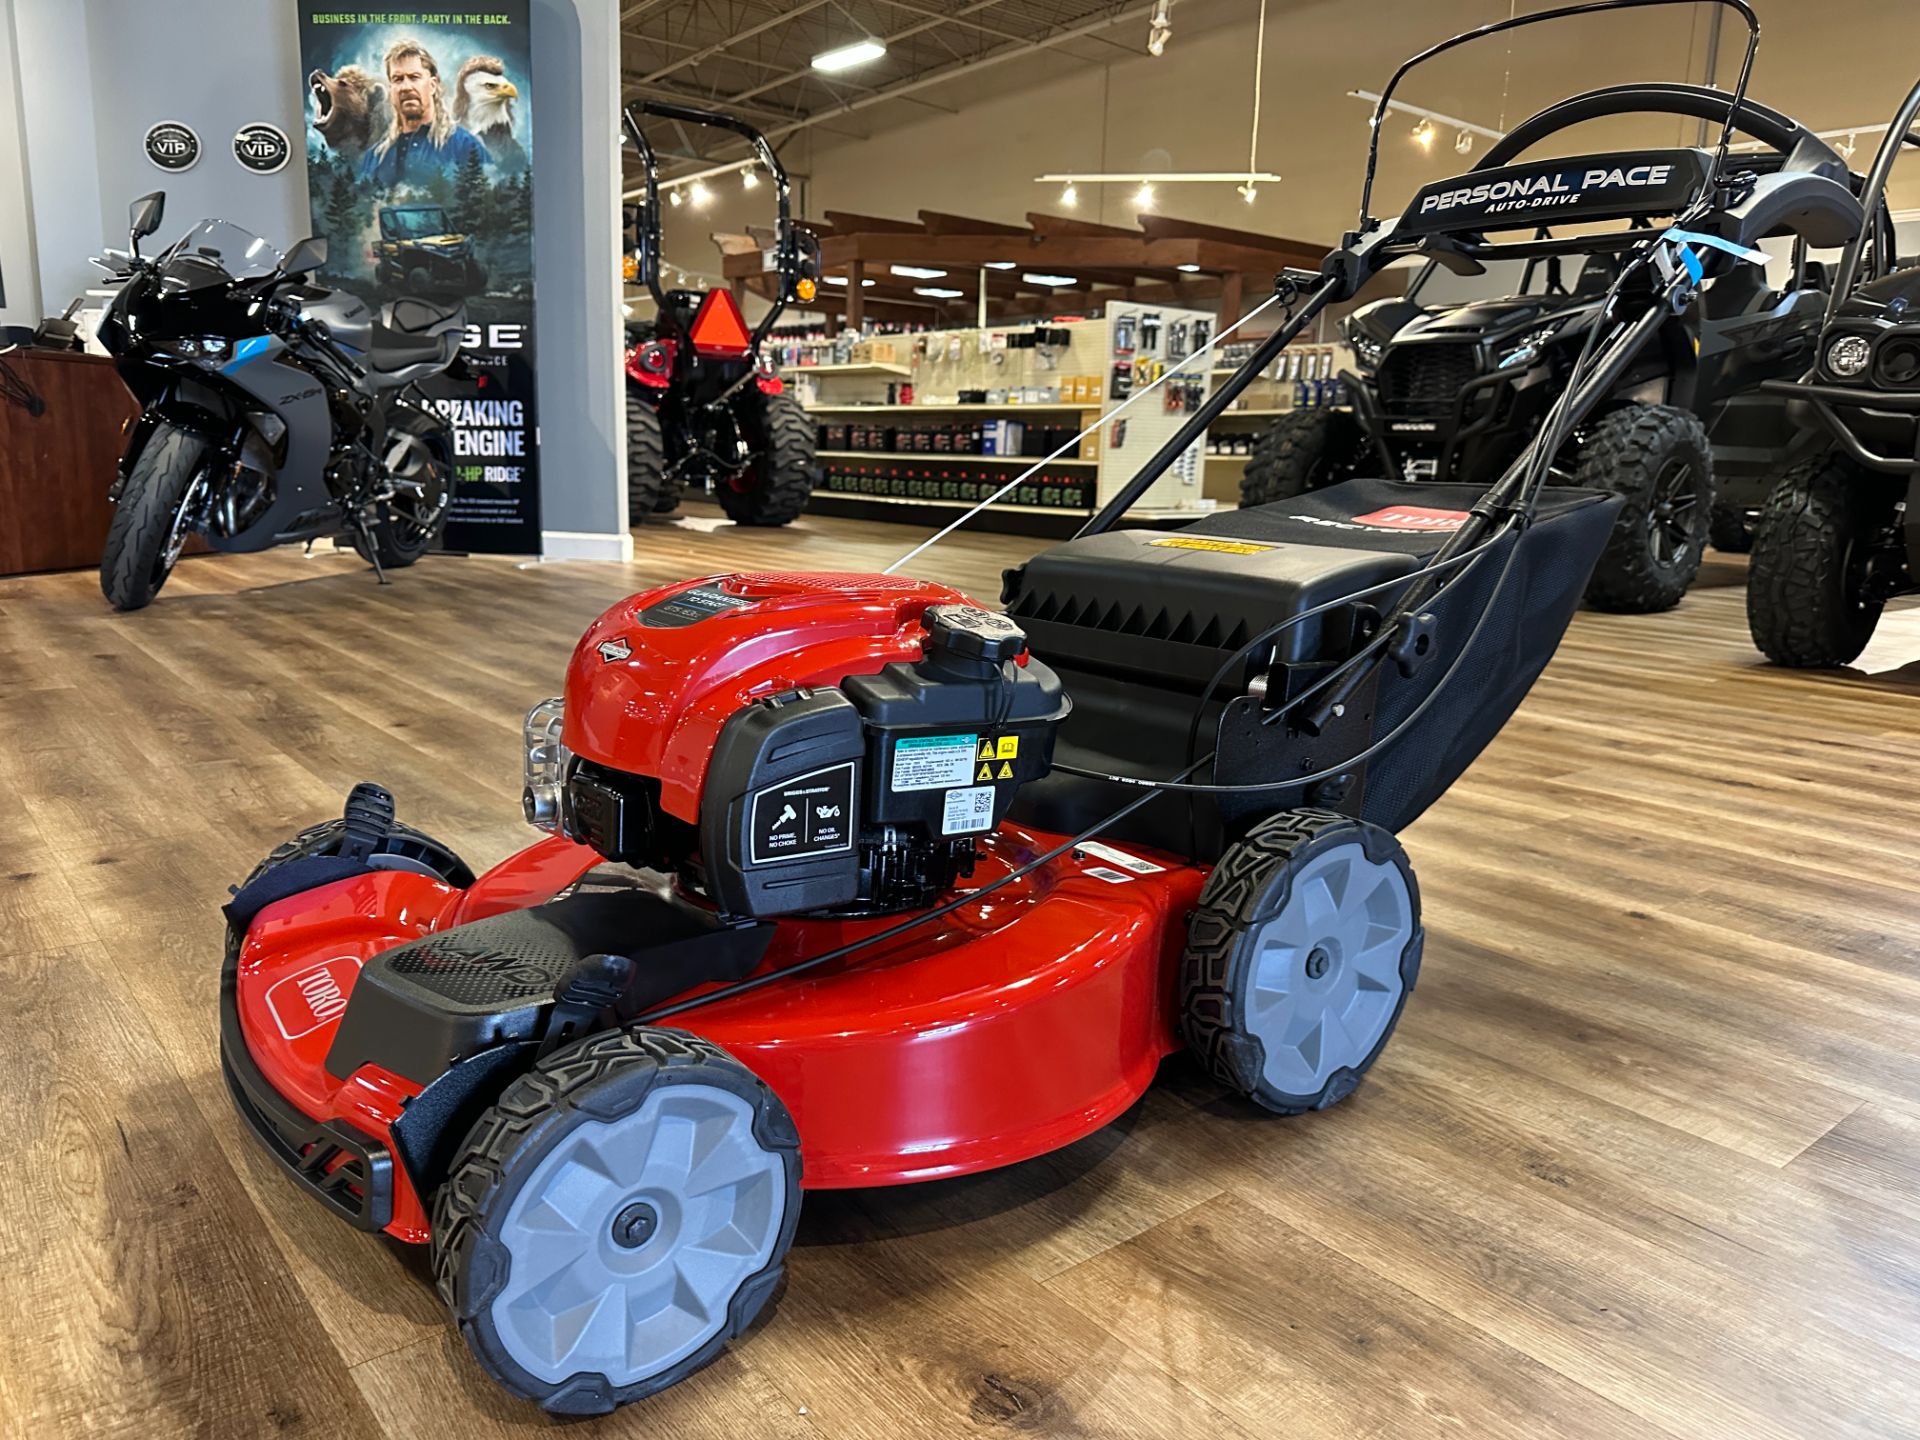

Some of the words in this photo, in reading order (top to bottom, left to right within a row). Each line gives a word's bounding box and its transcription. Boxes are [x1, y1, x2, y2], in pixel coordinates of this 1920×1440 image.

[312, 14, 356, 24] BUSINESS
[358, 14, 368, 24] IN
[370, 14, 387, 24] THE
[389, 14, 420, 24] FRONT.
[422, 14, 450, 24] PARTY
[452, 14, 462, 24] IN
[464, 14, 481, 24] THE
[484, 14, 511, 25] BACK.
[157, 142, 186, 154] VIP
[246, 144, 275, 156] VIP
[1419, 173, 1569, 215] PERSONAL
[1581, 164, 1672, 190] PACE
[1484, 193, 1581, 214] AUTO-DRIVE
[453, 429, 526, 457] ENGINE
[484, 465, 522, 483] RIDGE
[295, 966, 348, 1018] TORO
